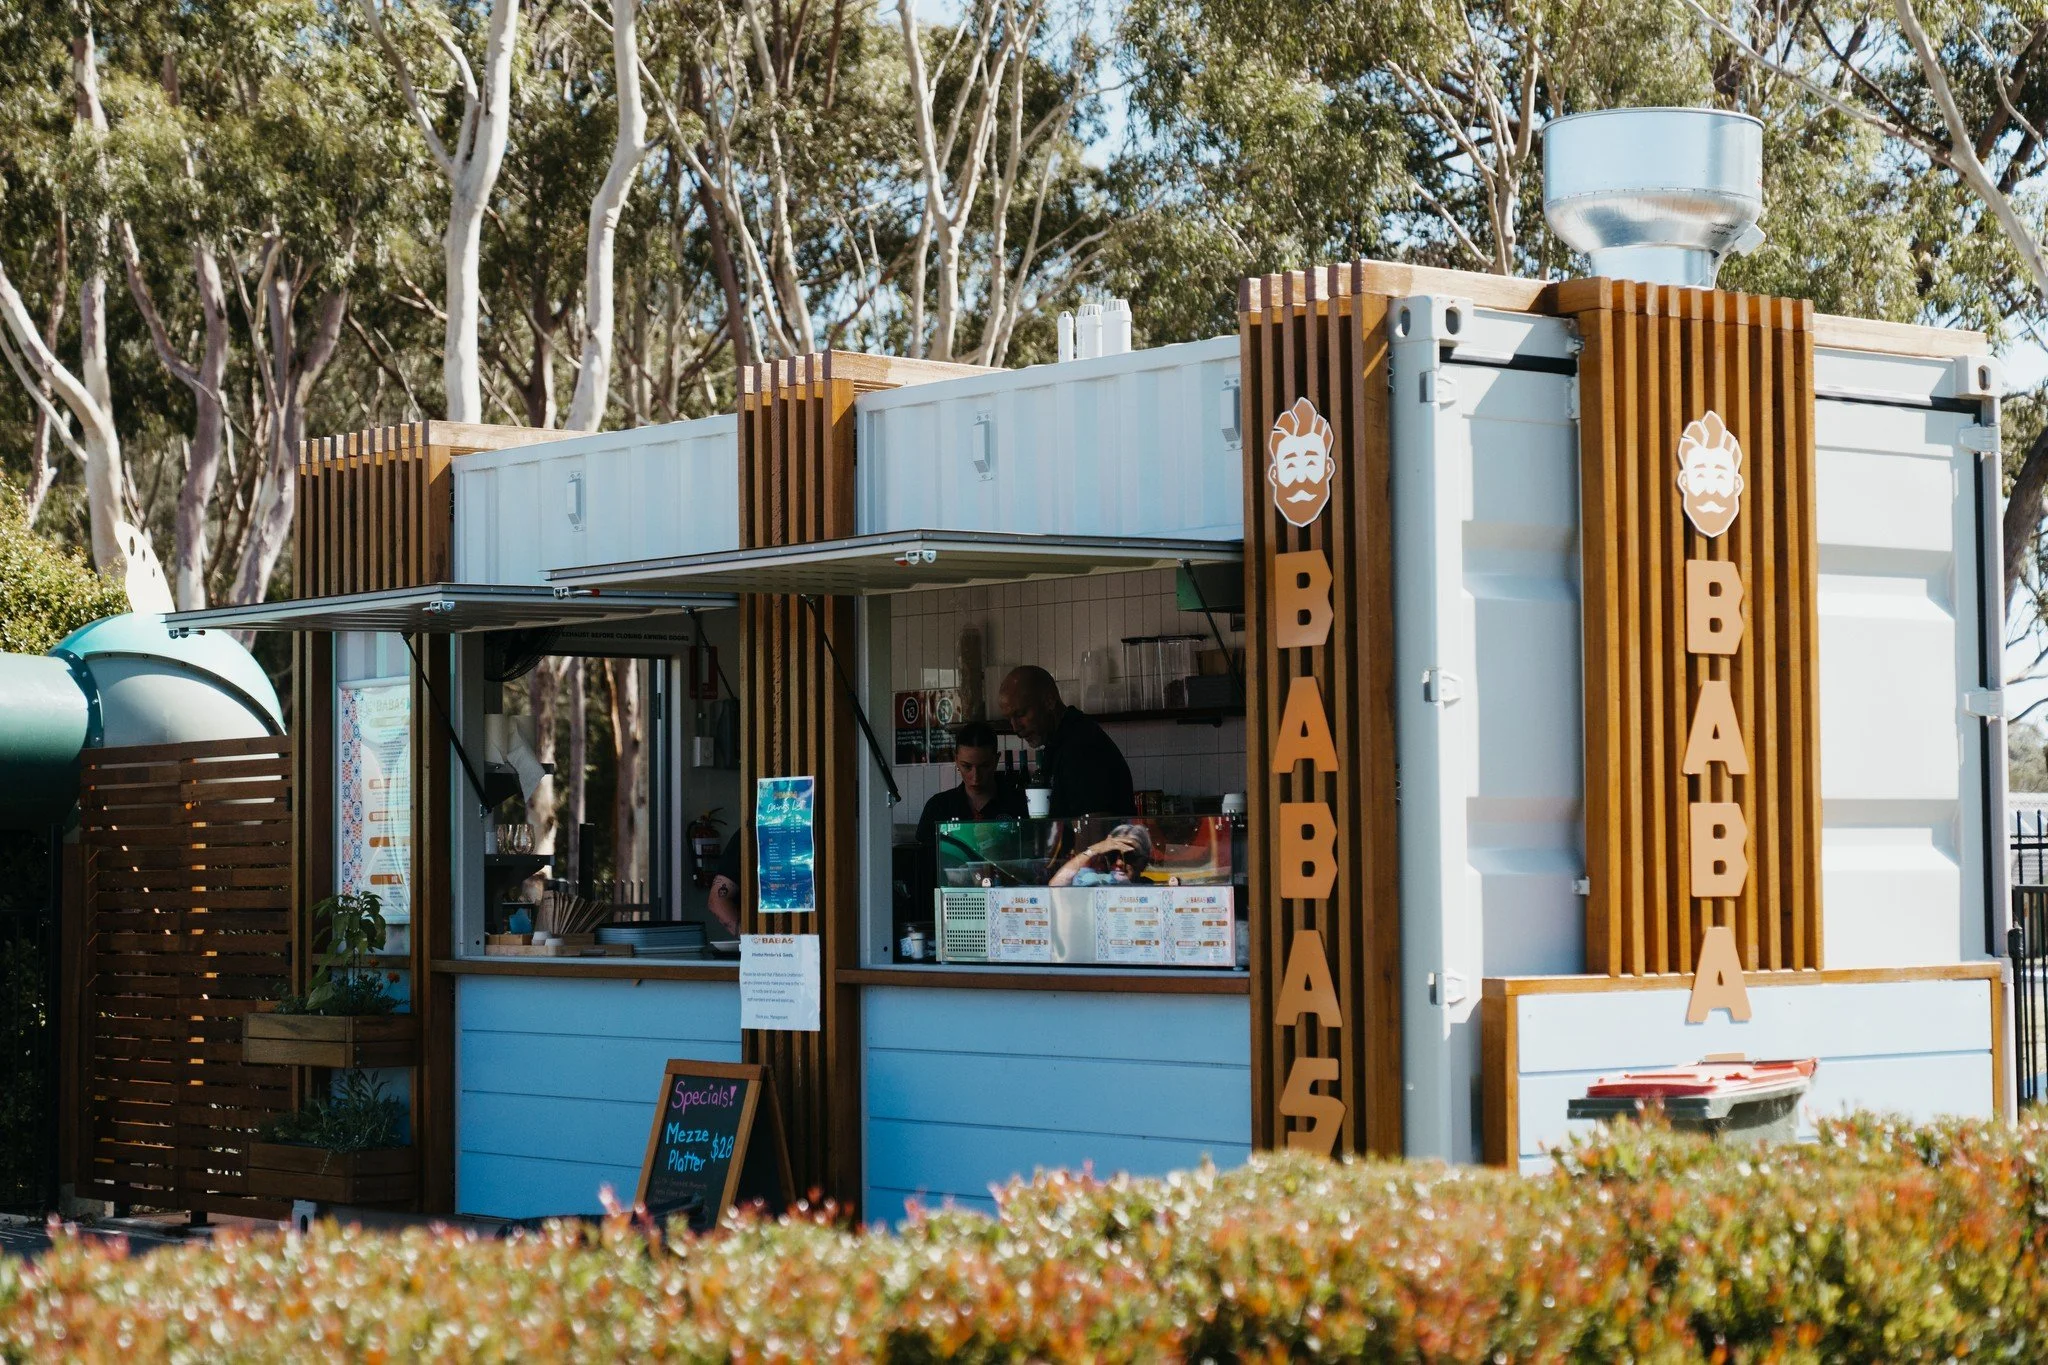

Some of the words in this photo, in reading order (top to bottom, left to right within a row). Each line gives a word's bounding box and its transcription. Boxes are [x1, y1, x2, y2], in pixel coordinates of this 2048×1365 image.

[644, 633, 668, 641] AWNING
[668, 634, 689, 642] DOORS
[1682, 559, 1751, 1061] BABA
[1272, 549, 1347, 1159] BABAS
[672, 1080, 737, 1115] Specials!
[665, 1122, 710, 1145] Mezze
[710, 1132, 735, 1163] $28
[667, 1149, 706, 1173] Platter
